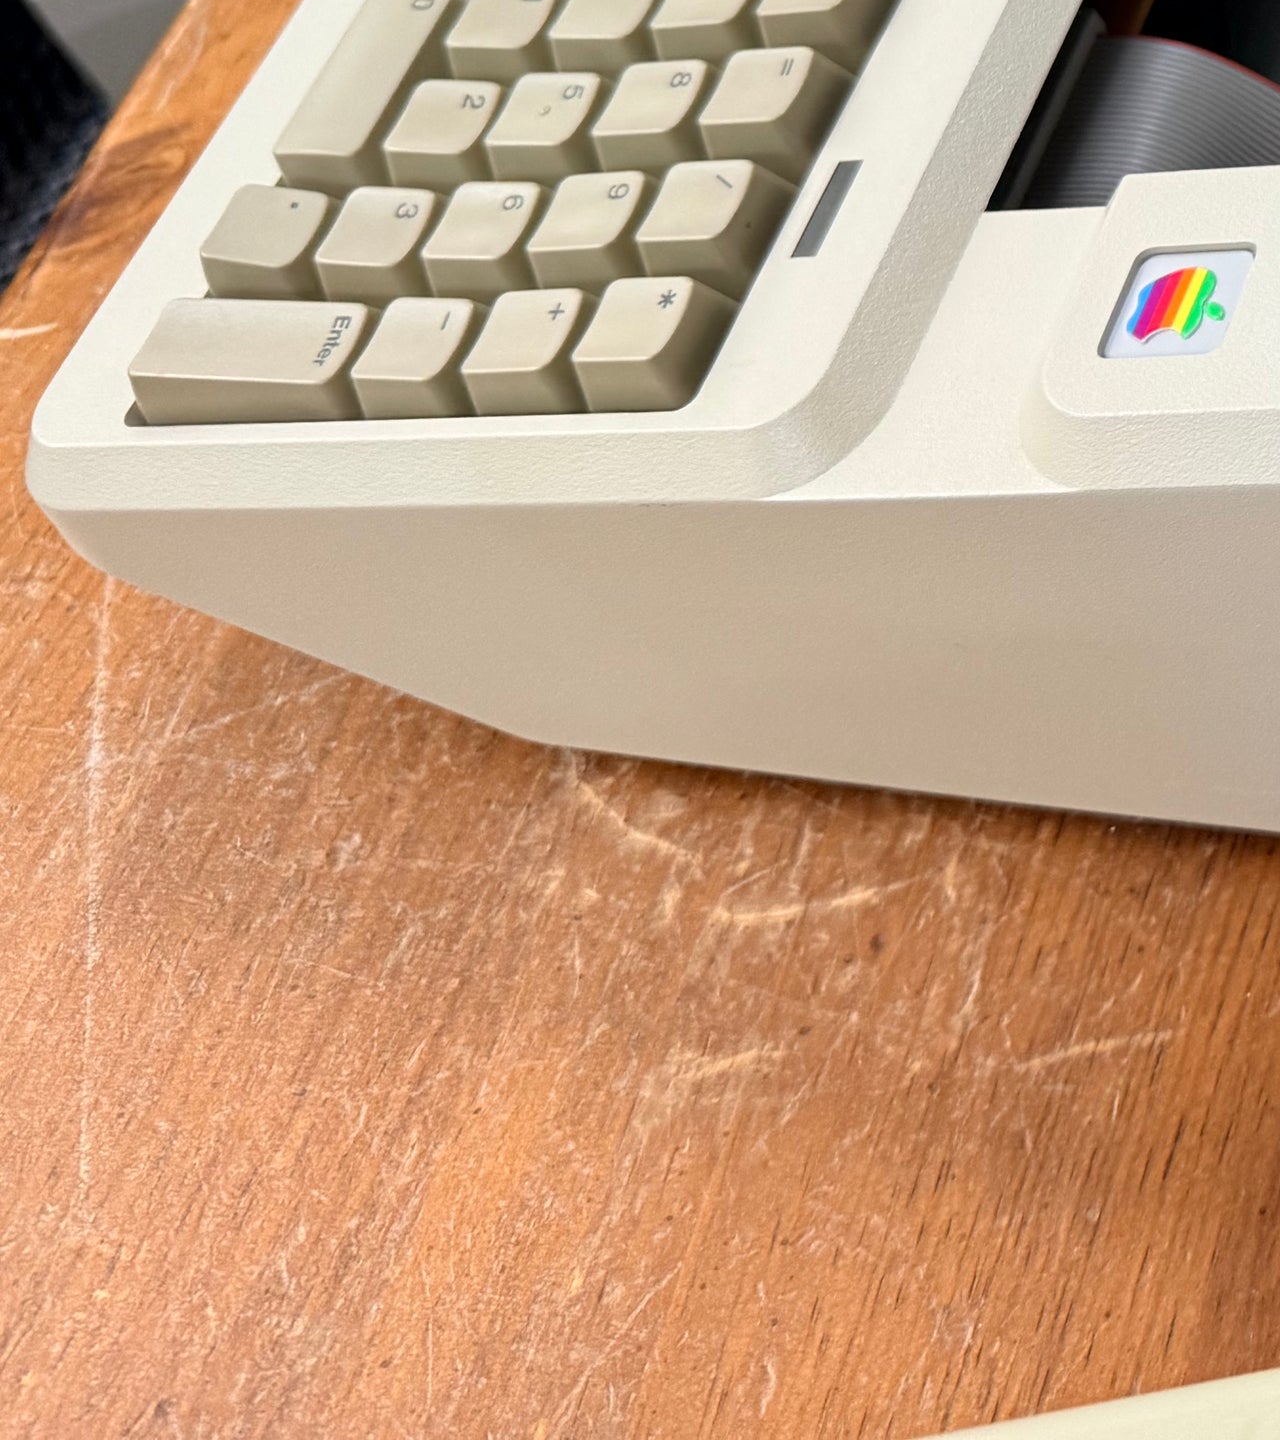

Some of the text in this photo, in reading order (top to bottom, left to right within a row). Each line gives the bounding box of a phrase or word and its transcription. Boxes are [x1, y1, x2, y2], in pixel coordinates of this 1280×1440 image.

[669, 71, 693, 89] 8
[461, 92, 486, 110] 2
[561, 84, 585, 101] 5
[607, 182, 630, 201] 9
[394, 202, 419, 220] 3
[501, 193, 525, 211] 6
[546, 302, 566, 321] +
[312, 313, 352, 369] Enter
